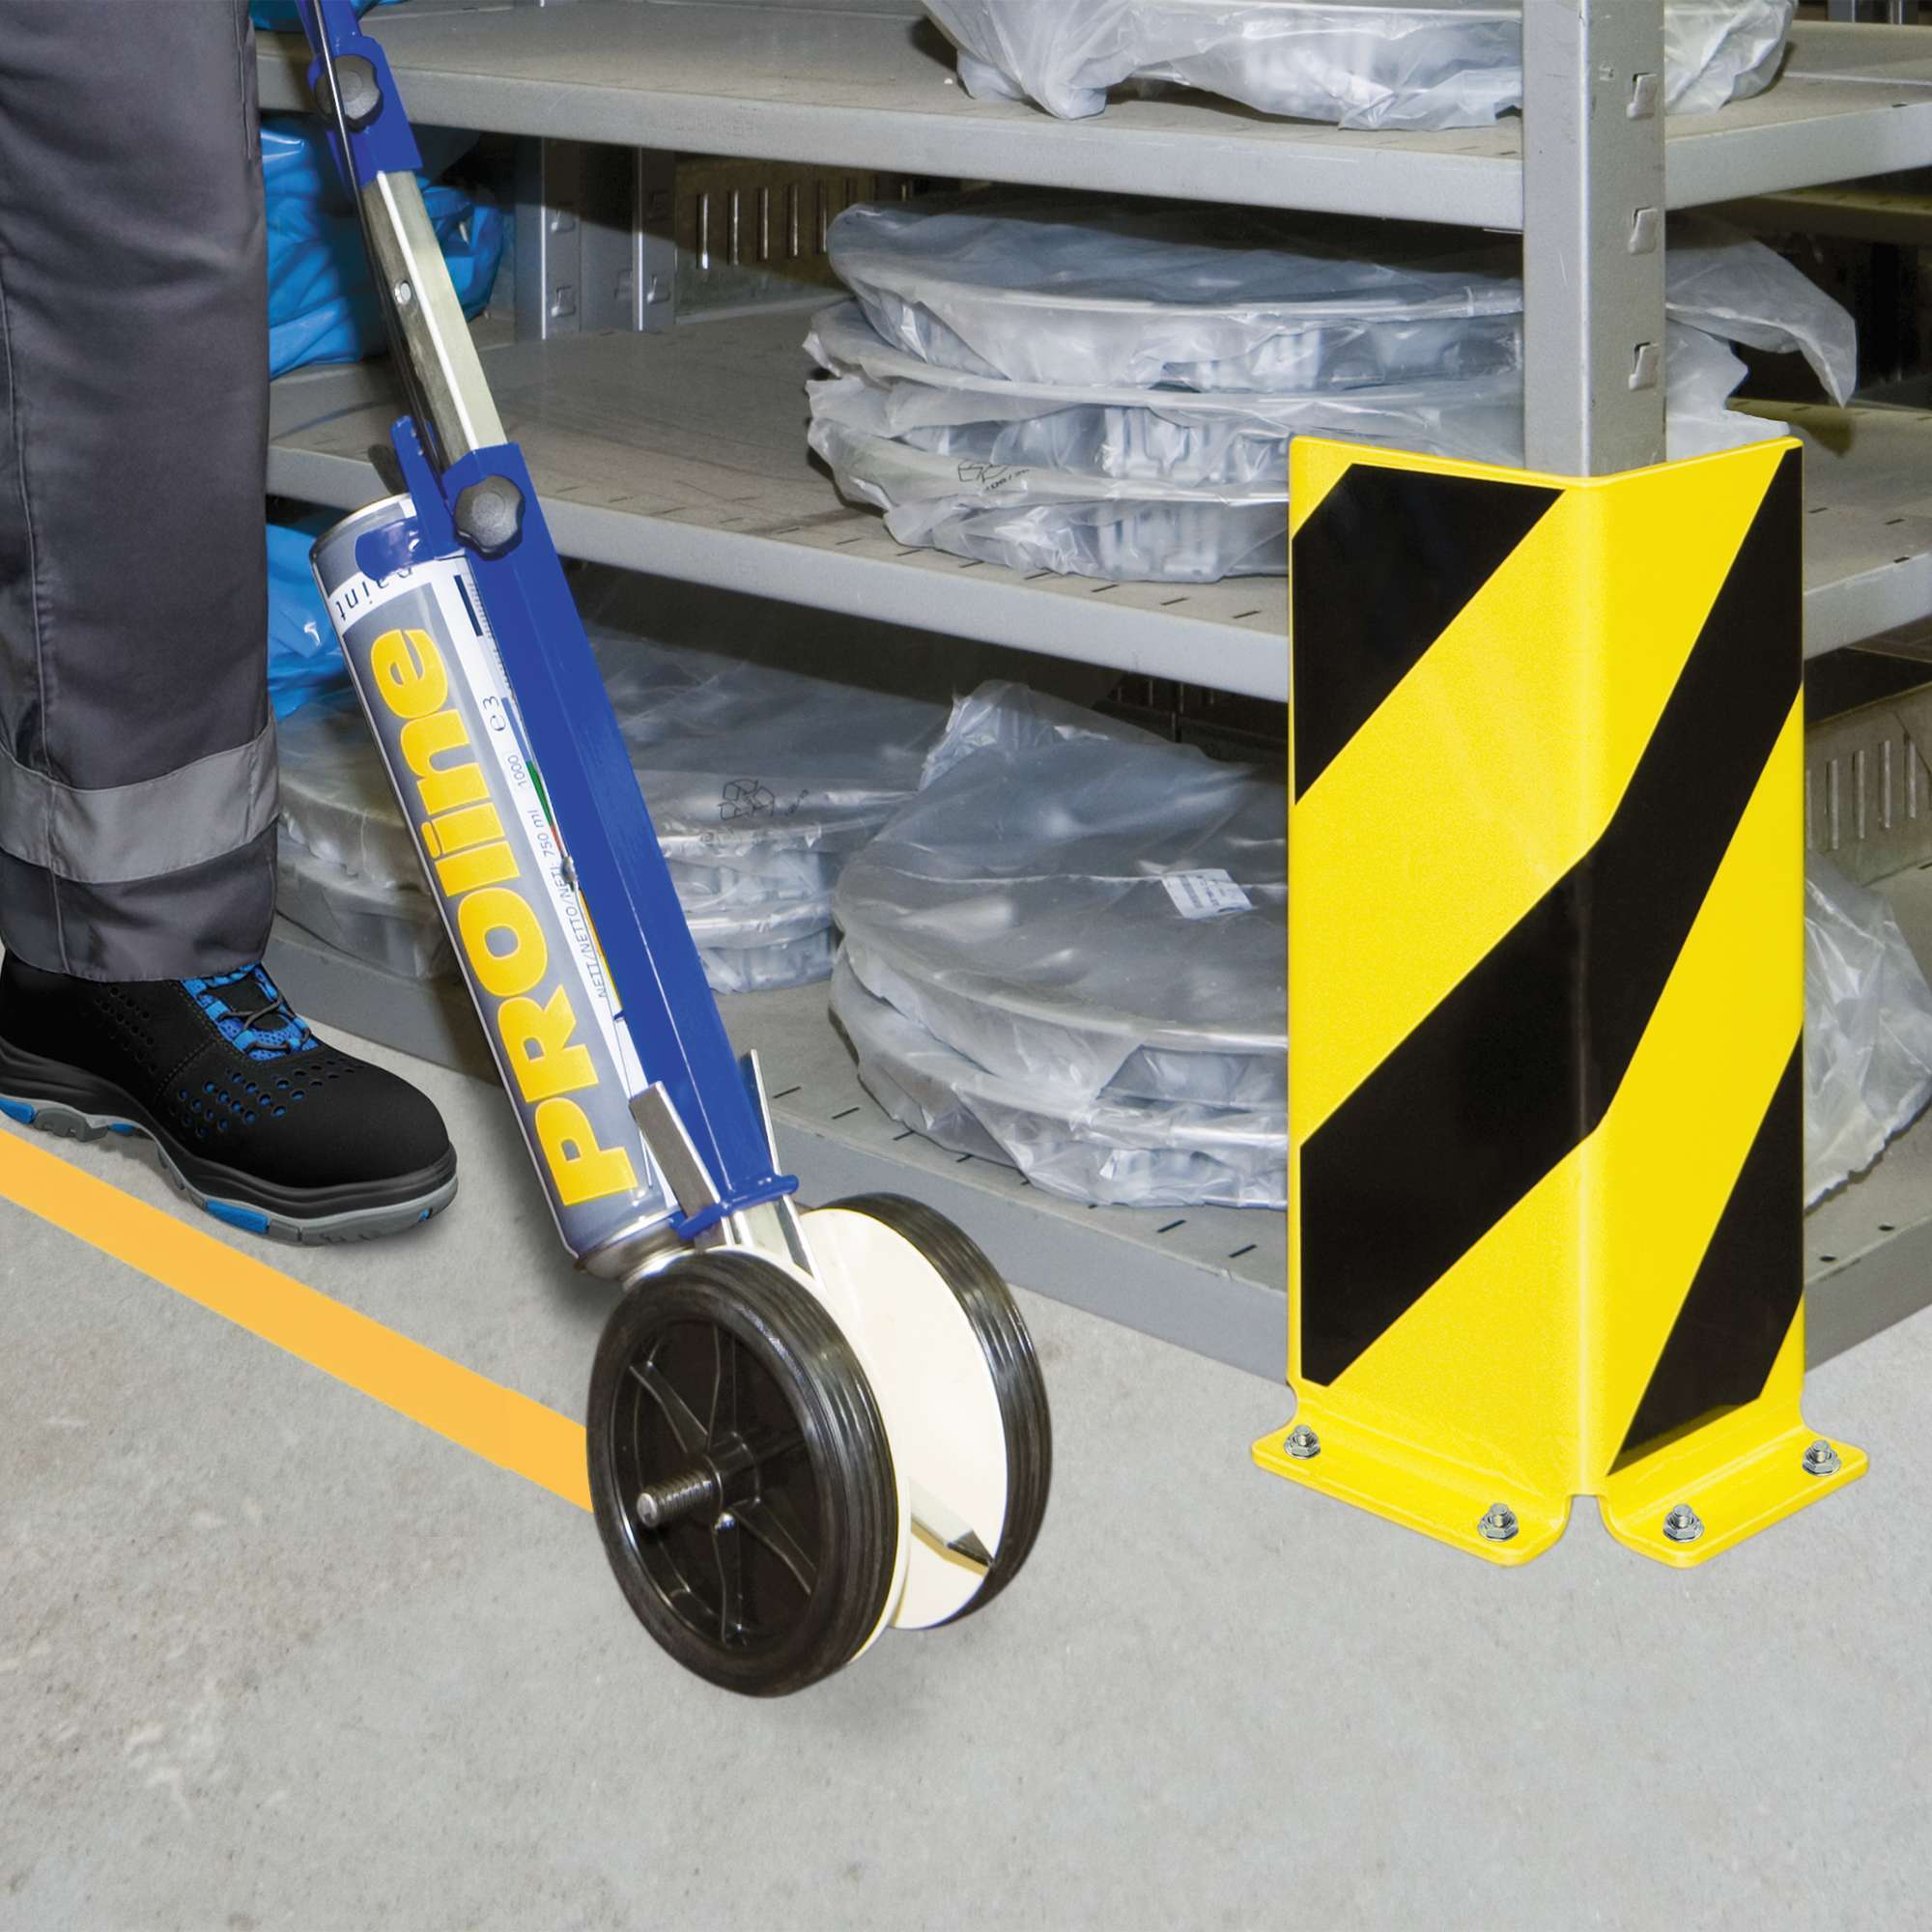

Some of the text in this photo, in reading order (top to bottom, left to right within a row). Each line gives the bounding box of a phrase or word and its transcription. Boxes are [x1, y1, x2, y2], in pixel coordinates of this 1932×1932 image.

[507, 754, 527, 788] 1000
[527, 809, 544, 828] ml
[537, 833, 555, 858] 750
[370, 629, 639, 1206] PROline
